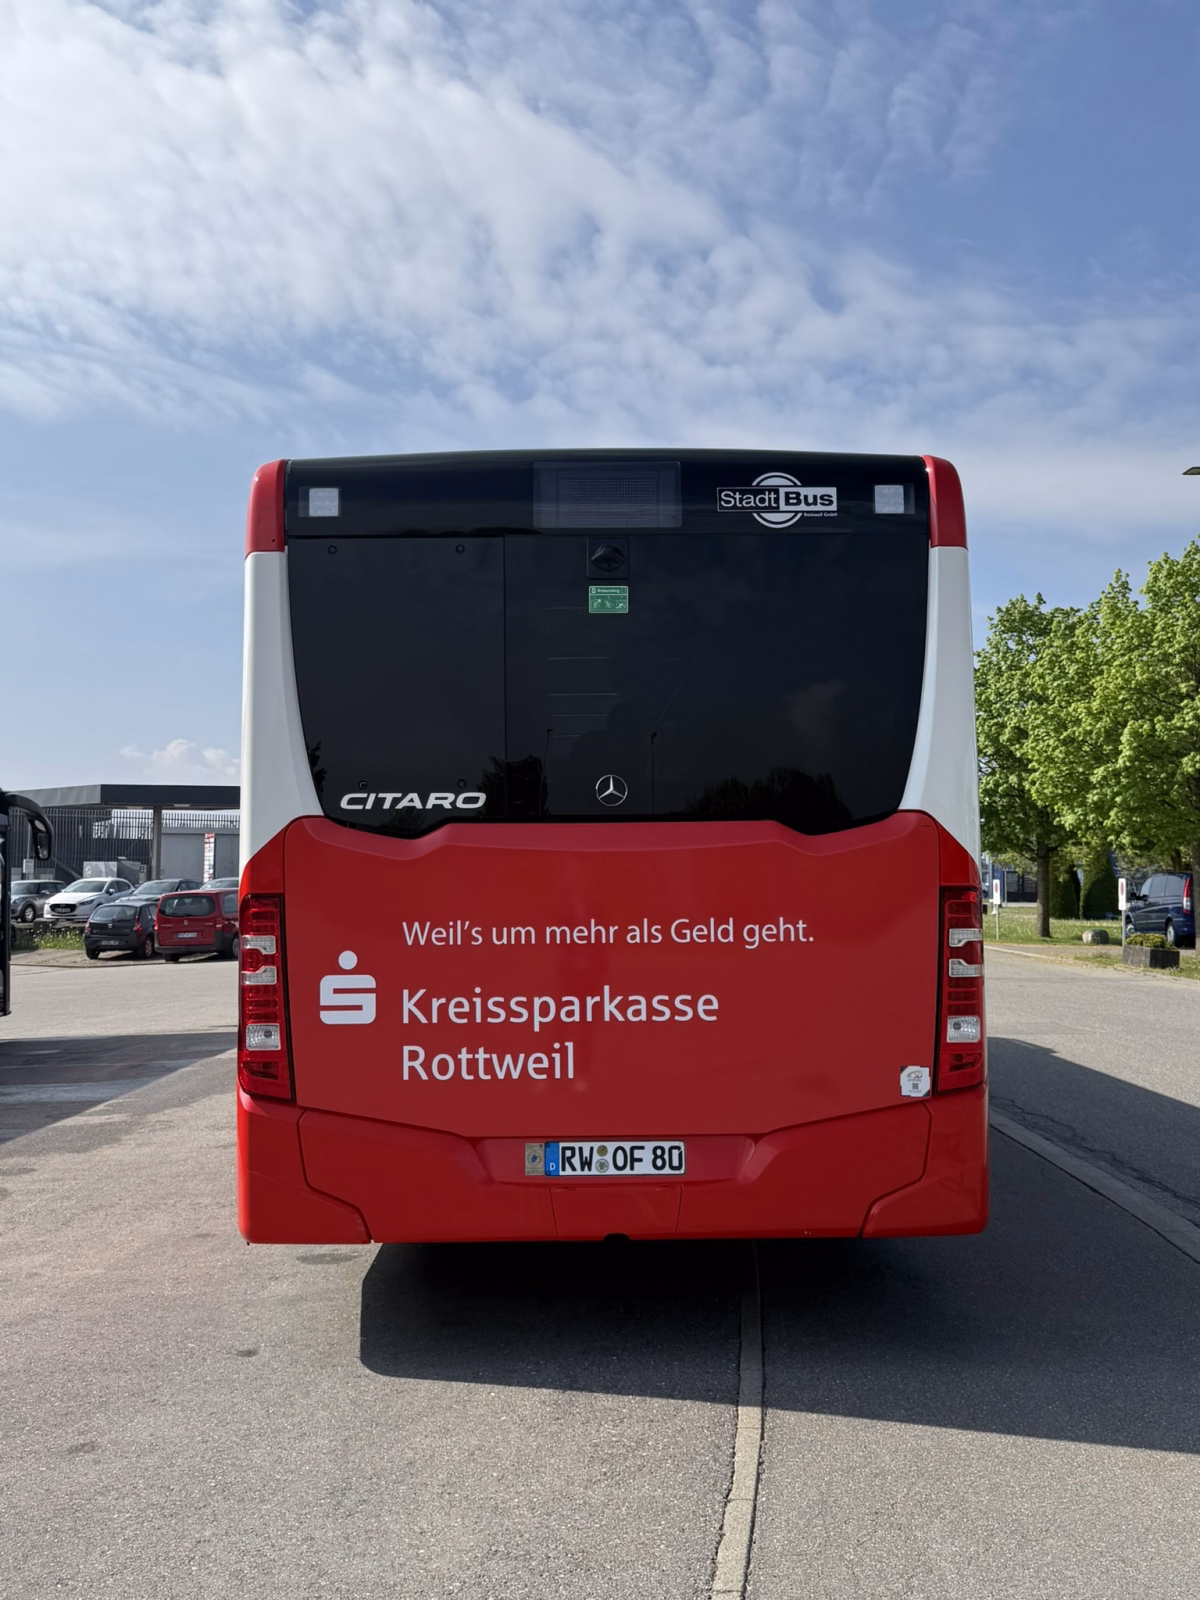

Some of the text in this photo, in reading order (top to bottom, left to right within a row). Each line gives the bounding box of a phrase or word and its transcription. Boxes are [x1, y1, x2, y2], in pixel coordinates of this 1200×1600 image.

[720, 490, 834, 507] Stadt Bus
[340, 792, 487, 810] CITARO
[402, 917, 814, 949] Weil's um mehr als Geld geht.
[402, 985, 719, 1033] Kreissparkasse
[402, 1042, 574, 1081] Rottweil
[549, 1162, 556, 1171] D
[560, 1146, 595, 1172] RW
